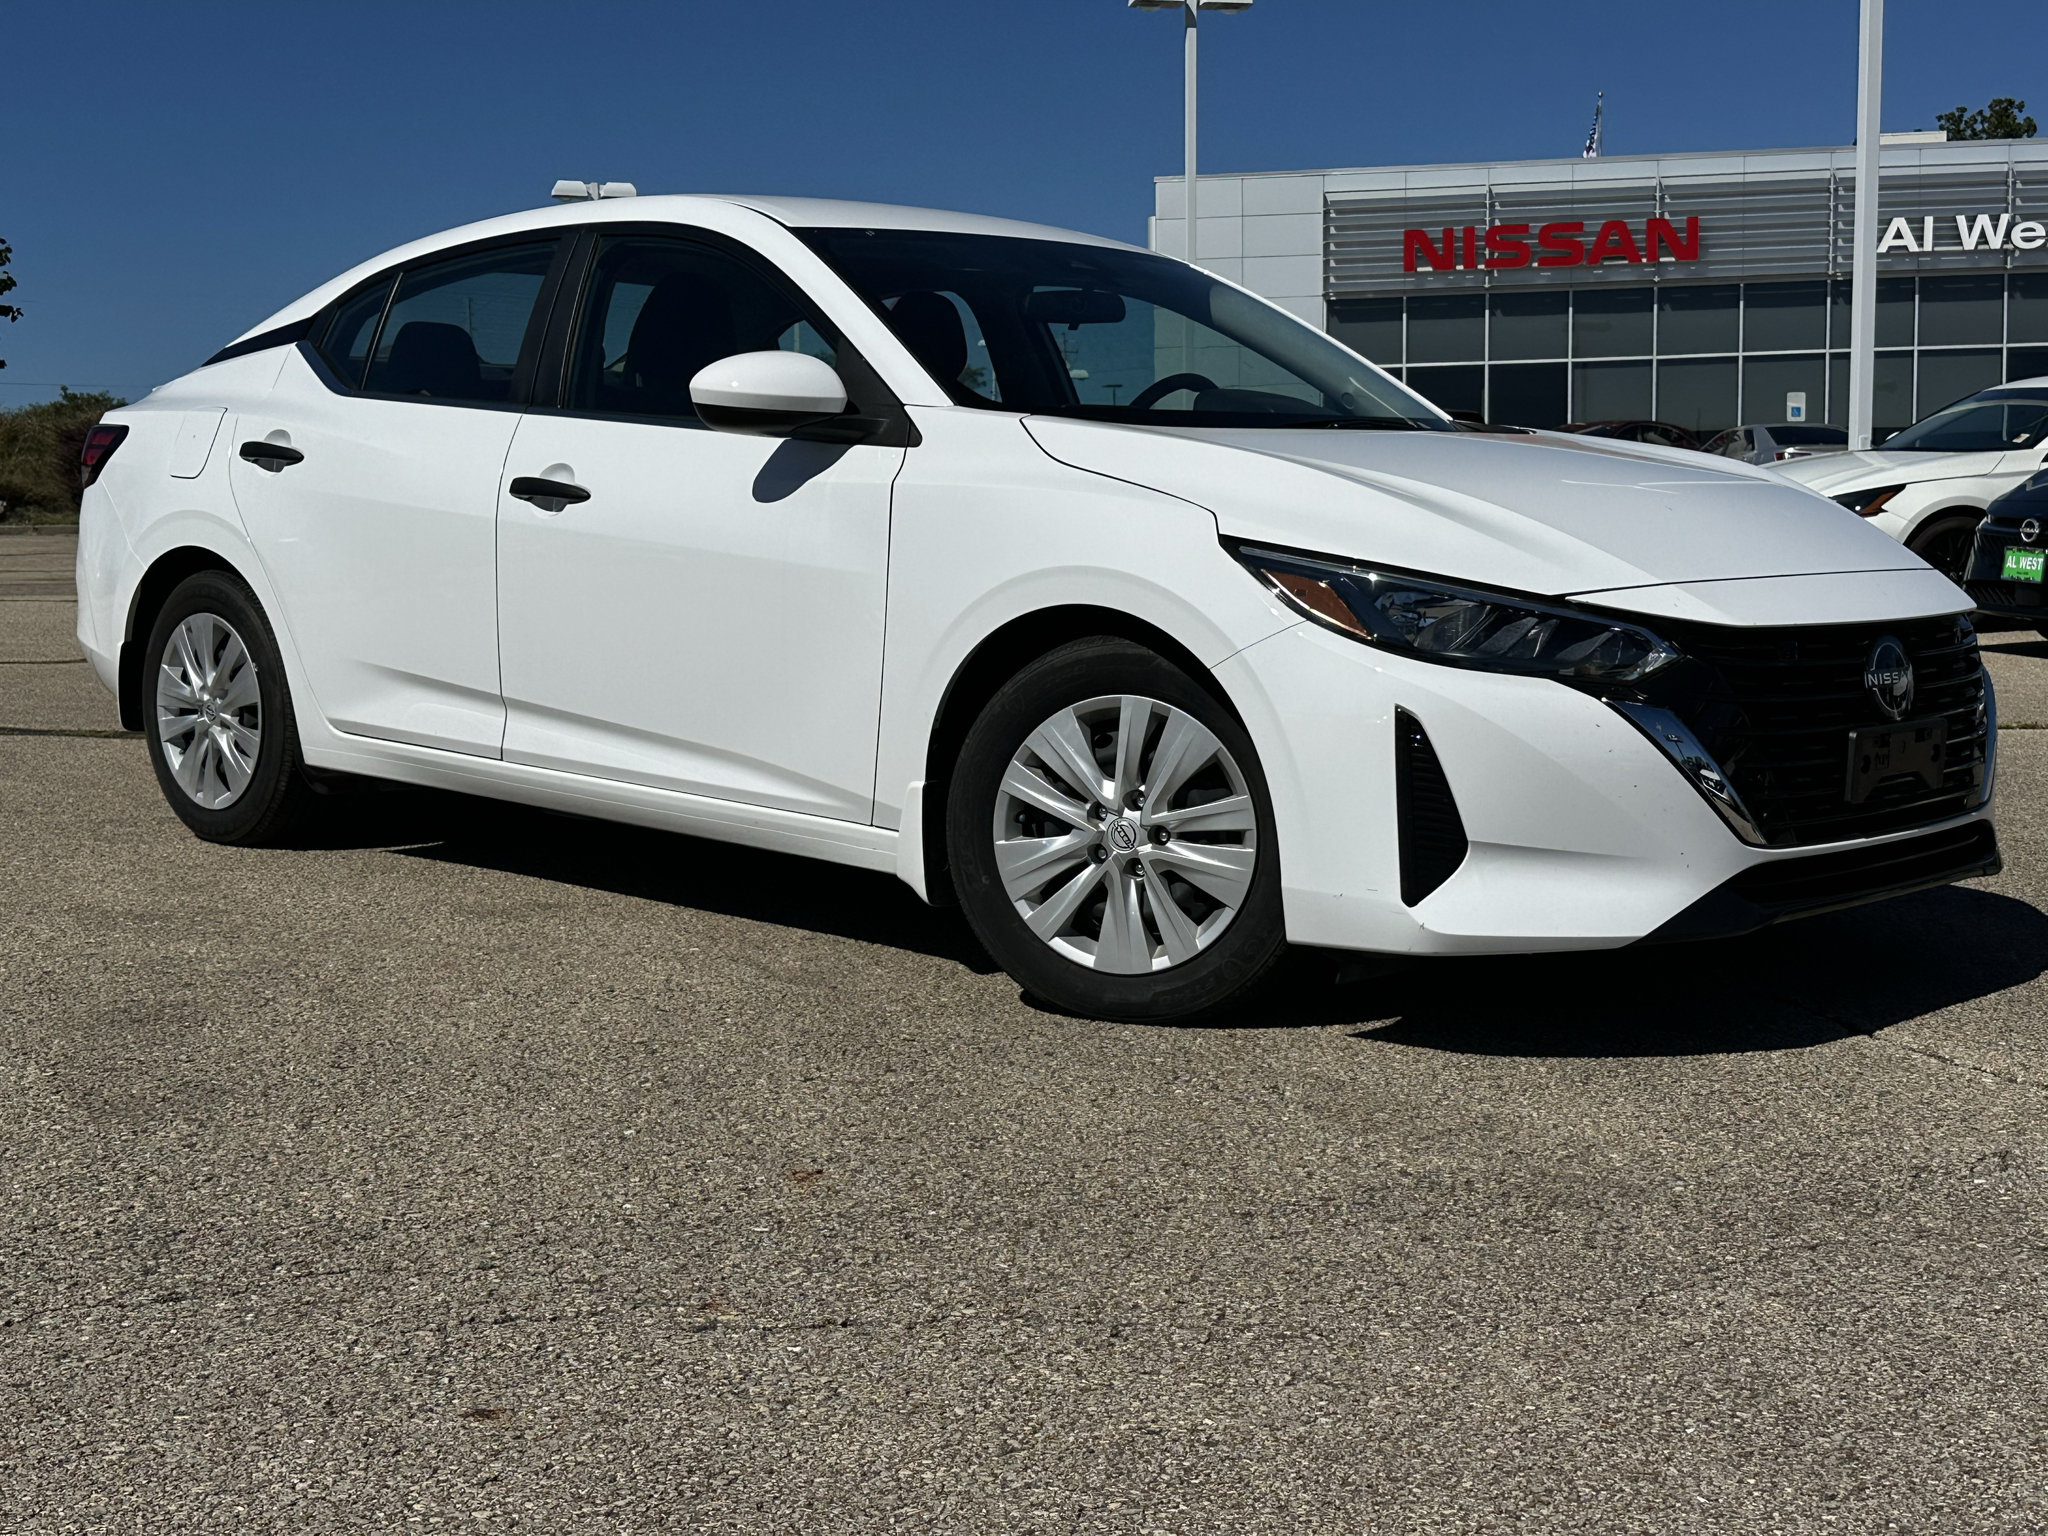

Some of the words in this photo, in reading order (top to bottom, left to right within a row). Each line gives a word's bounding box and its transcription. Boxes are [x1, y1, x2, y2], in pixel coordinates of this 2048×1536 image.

[1403, 217, 1699, 272] NISSAN
[1877, 215, 1934, 253] Al
[2006, 556, 2017, 568] AL
[2019, 557, 2044, 571] WEST
